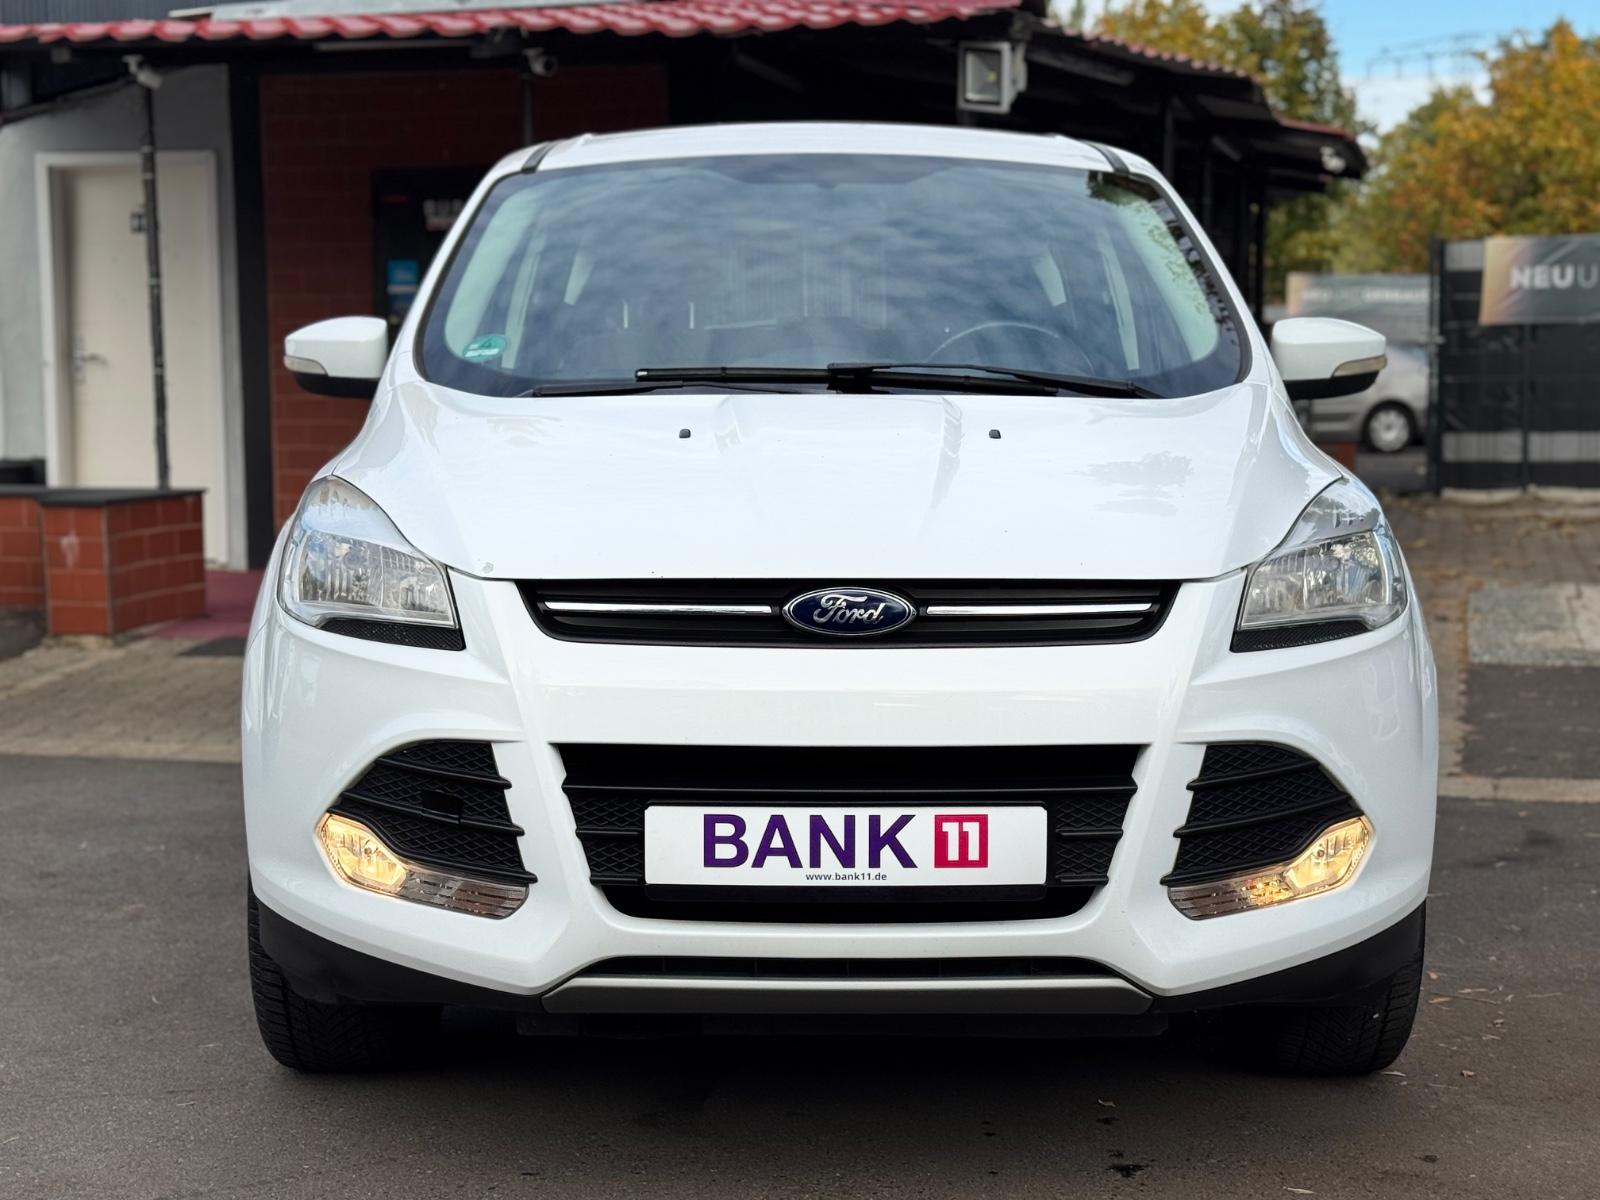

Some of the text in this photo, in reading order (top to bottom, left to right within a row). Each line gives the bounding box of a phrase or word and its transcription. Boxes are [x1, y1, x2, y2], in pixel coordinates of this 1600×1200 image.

[812, 594, 886, 624] Ford
[703, 813, 981, 869] BANK 11
[805, 872, 888, 882] www.bank11.de
